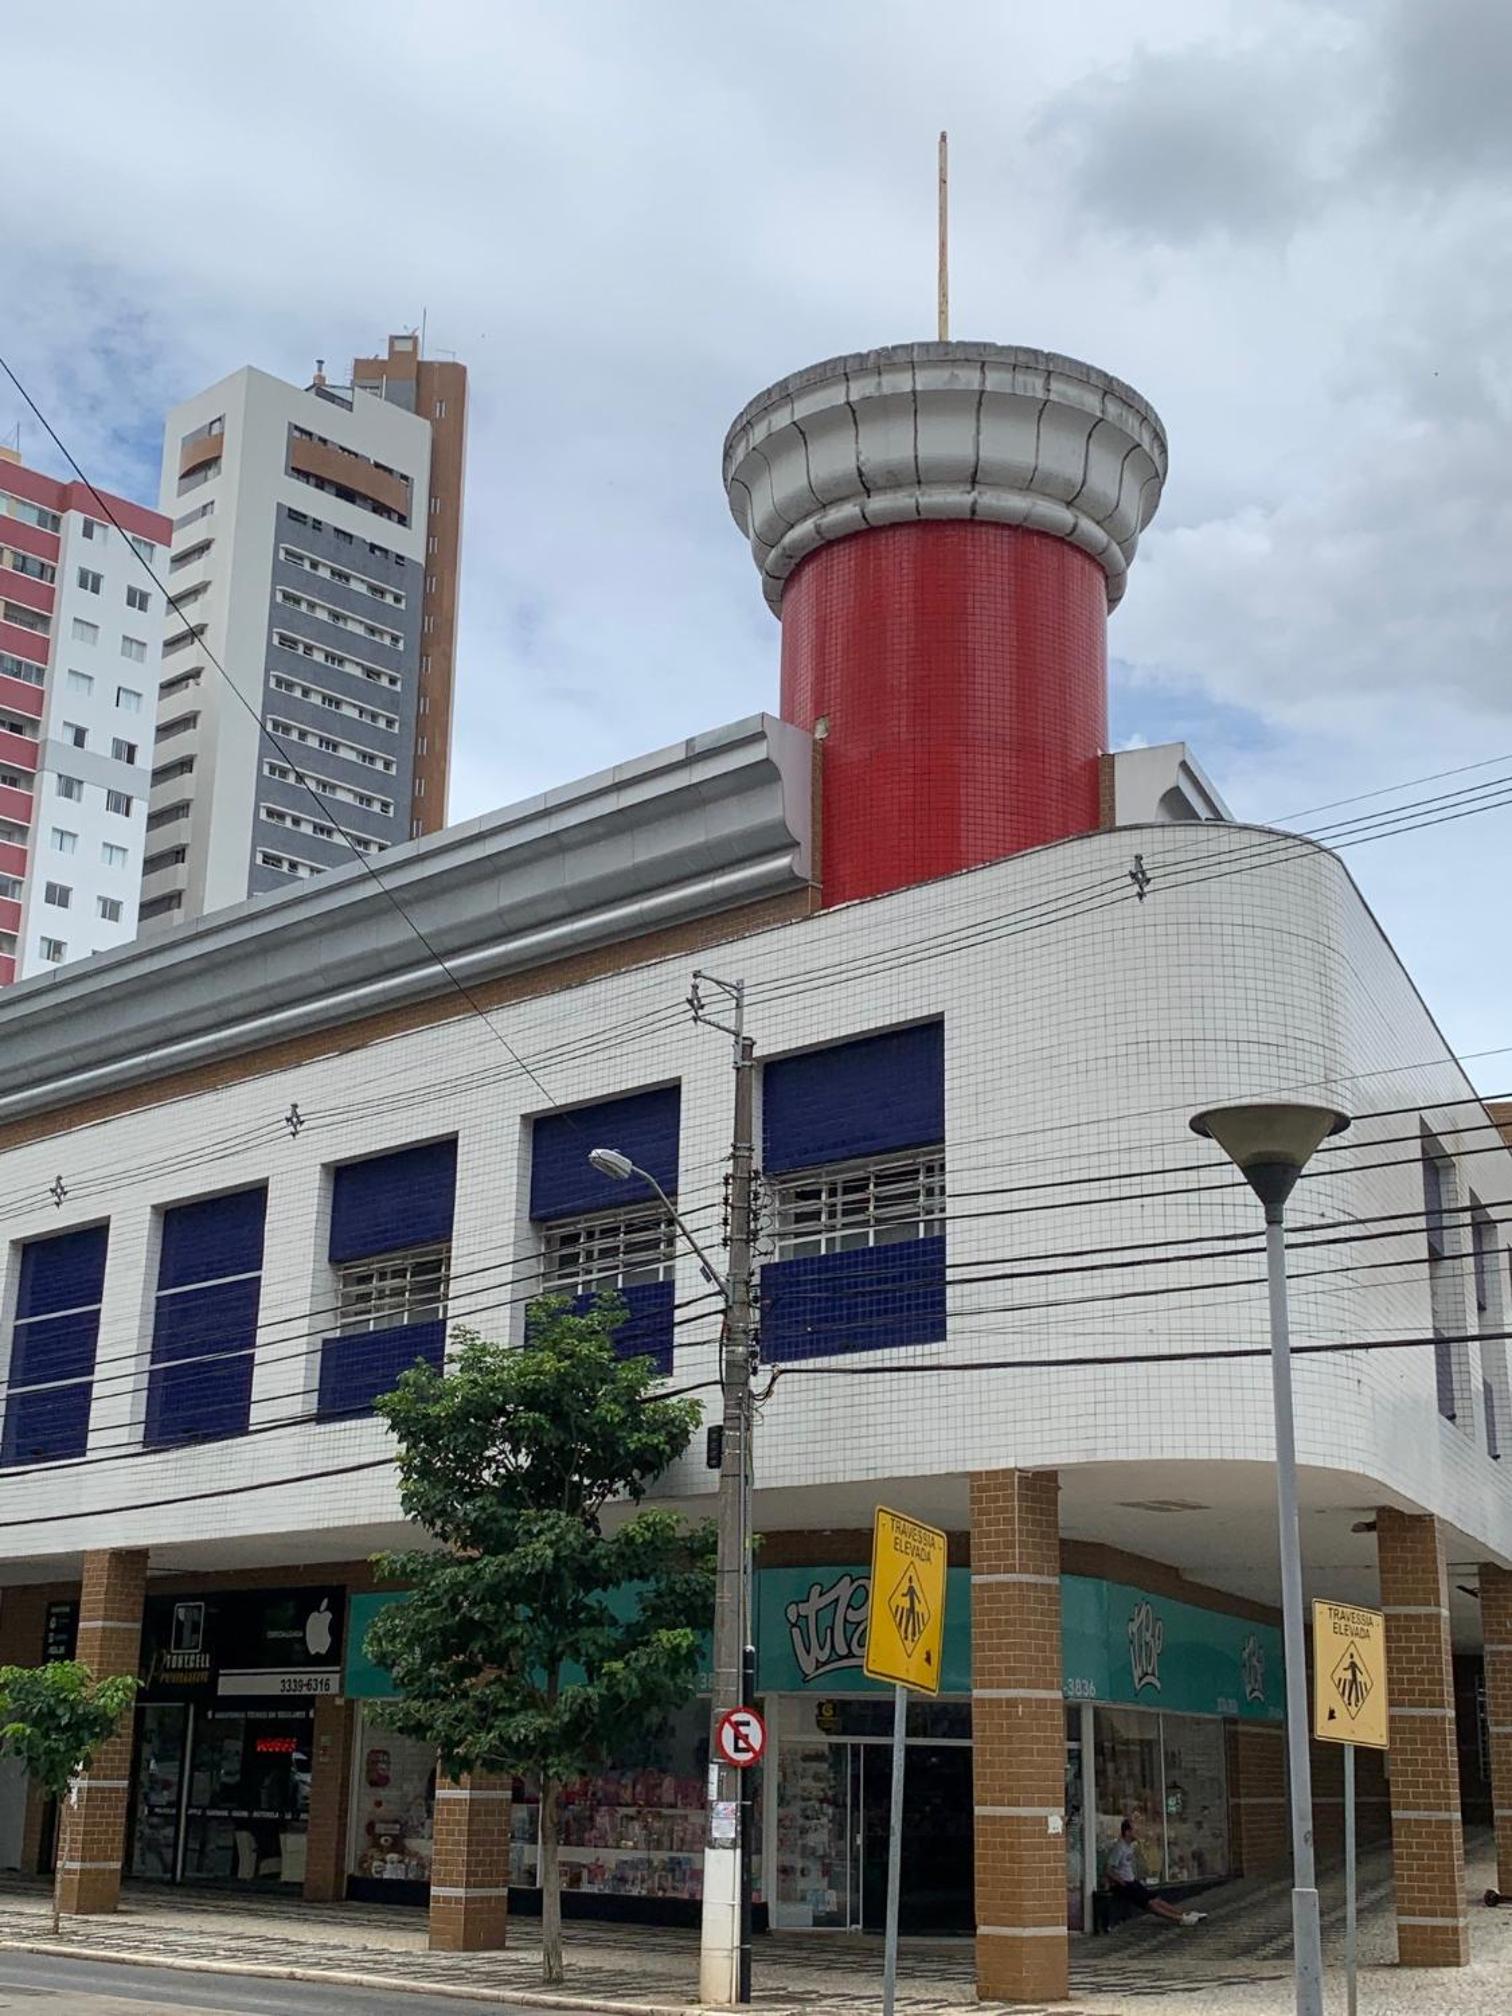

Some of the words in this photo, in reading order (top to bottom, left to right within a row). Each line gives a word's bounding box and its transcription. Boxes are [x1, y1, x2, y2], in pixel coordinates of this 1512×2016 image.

[890, 1517, 936, 1550] TRAVESSIA
[893, 1536, 933, 1565] ELEVADA
[1328, 1607, 1375, 1628] TRAVESSIA
[1332, 1621, 1371, 1641] ELEVADA
[280, 1678, 331, 1694] 3339-6316
[733, 1720, 751, 1753] E
